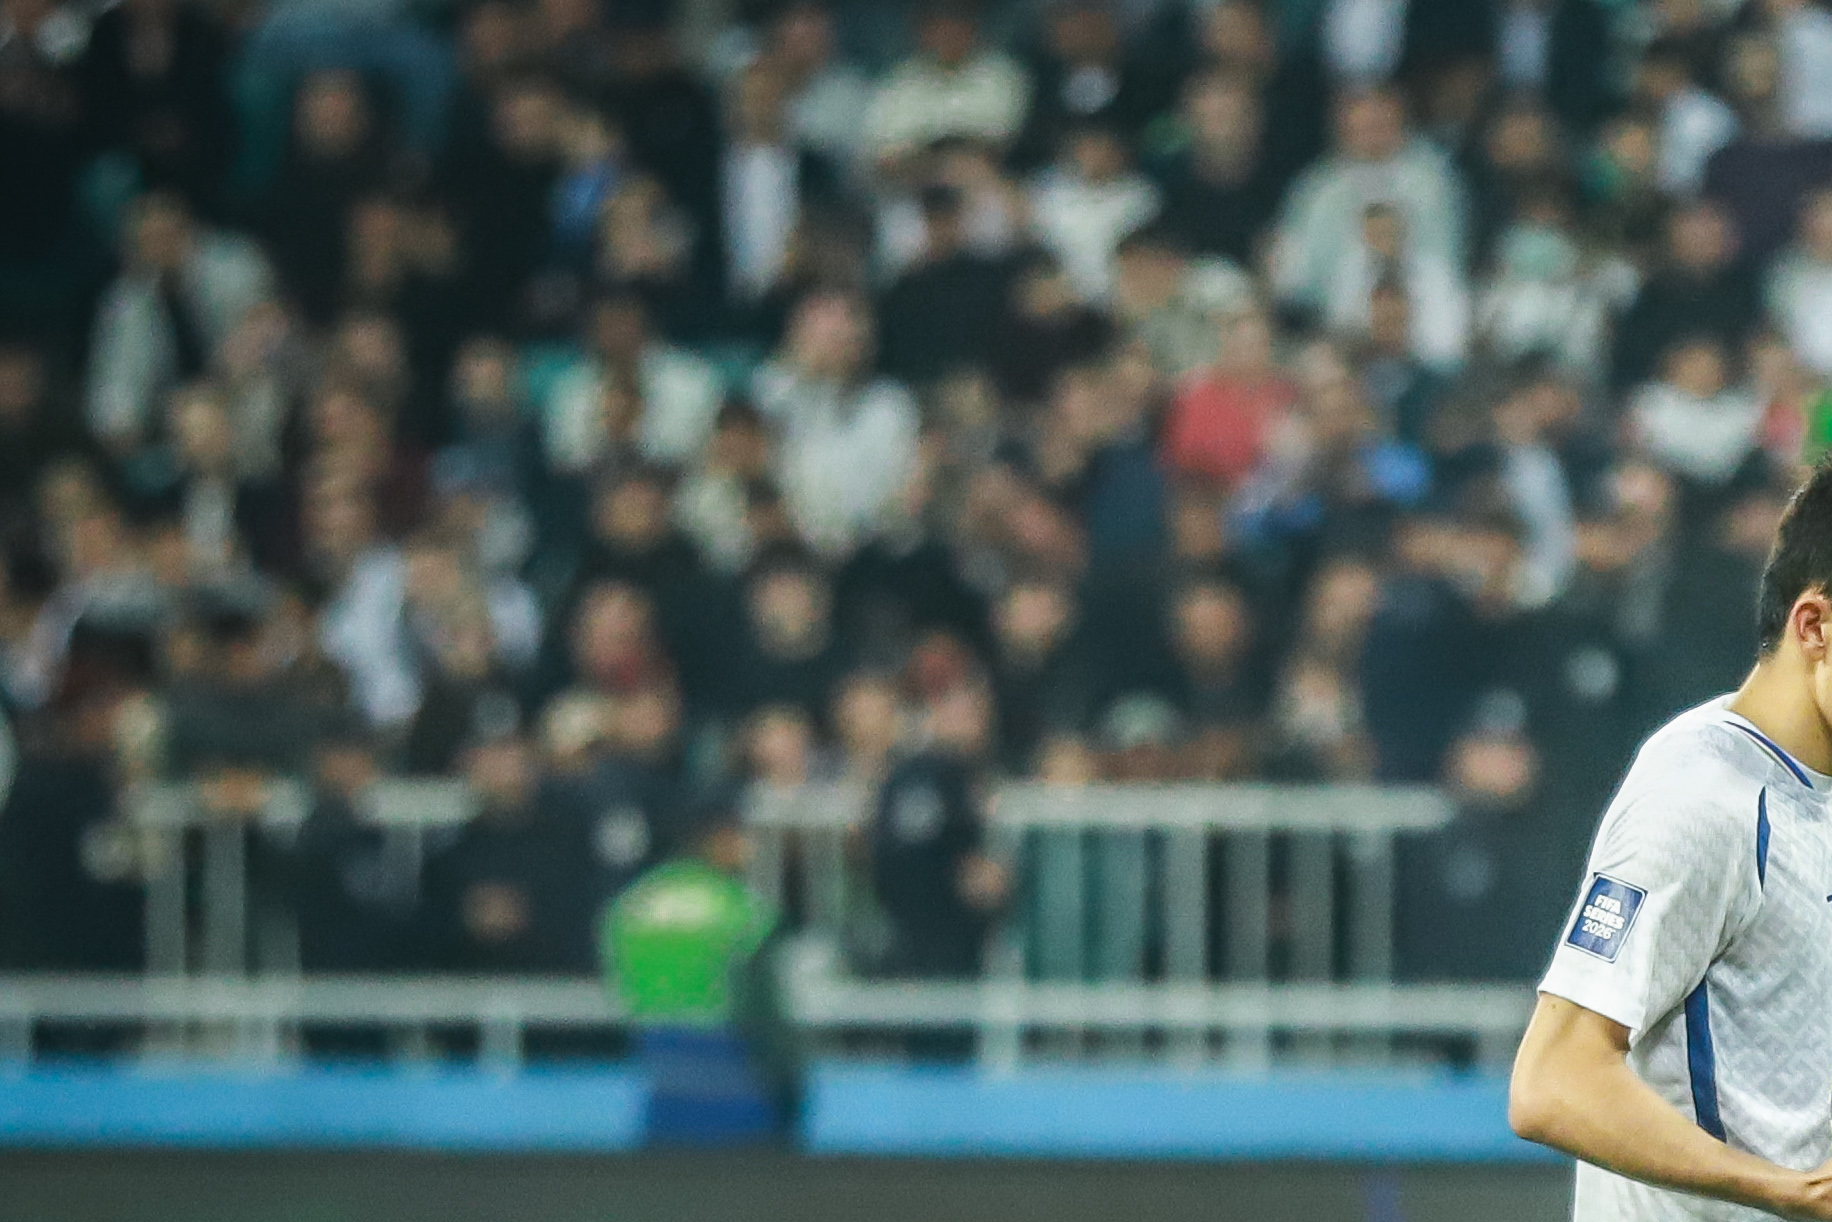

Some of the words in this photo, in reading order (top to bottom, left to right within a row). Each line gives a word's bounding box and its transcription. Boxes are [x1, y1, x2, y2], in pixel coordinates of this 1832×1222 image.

[1594, 894, 1621, 914] FIFA
[1583, 904, 1625, 930] SERIES
[1582, 919, 1613, 940] 2026
